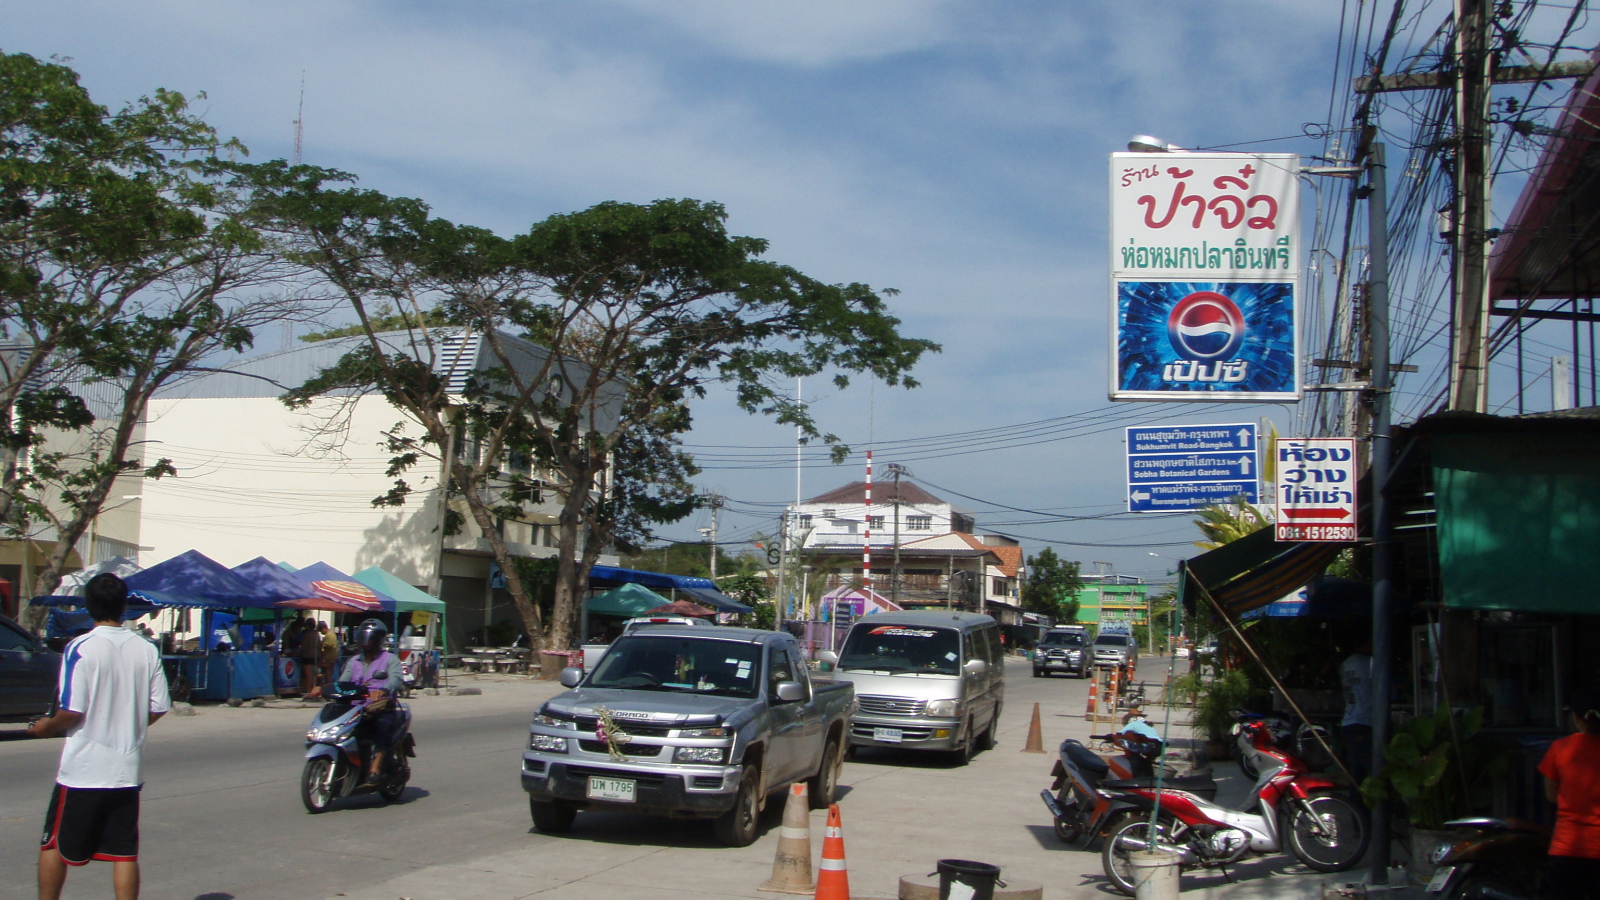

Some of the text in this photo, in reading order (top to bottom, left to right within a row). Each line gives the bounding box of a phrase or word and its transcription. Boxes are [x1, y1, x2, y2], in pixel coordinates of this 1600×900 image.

[1121, 164, 1160, 187] ร้าน
[1137, 163, 1278, 230] ป้าจิ๋ว
[1121, 235, 1290, 270] ห่อหมกปลาอินทรี
[1135, 443, 1177, 451] Sukhumvit
[1279, 443, 1351, 462] ห้อง
[1133, 470, 1158, 478] Sobha
[1159, 469, 1196, 477] Botanical
[1284, 464, 1348, 483] ว่าง
[1280, 484, 1353, 504] ให้เช่า
[610, 781, 633, 793] 1795
